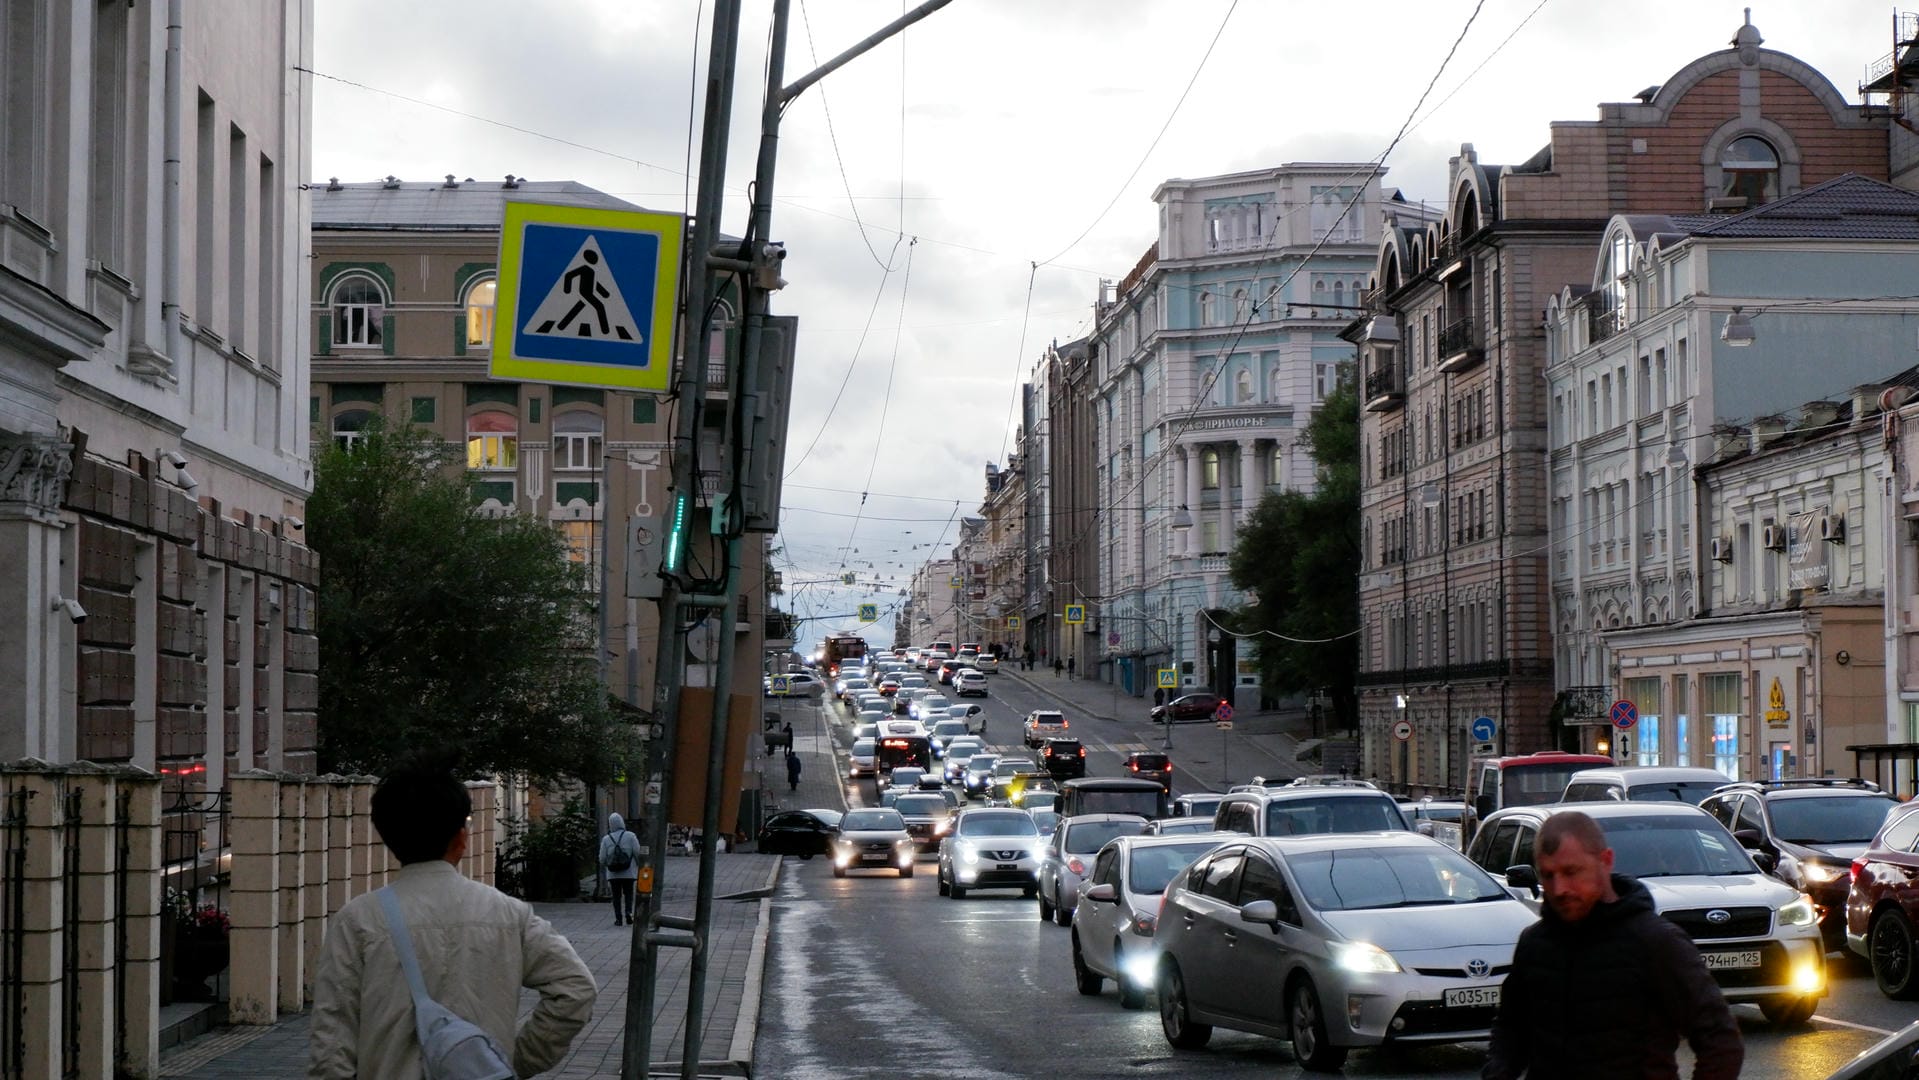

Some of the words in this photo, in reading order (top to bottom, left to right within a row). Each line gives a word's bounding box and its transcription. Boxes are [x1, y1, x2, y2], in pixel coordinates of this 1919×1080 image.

[1205, 417, 1265, 429] ПРИМОРЬЕ
[1741, 953, 1759, 962] 125
[1450, 990, 1498, 1005] К035ТР
